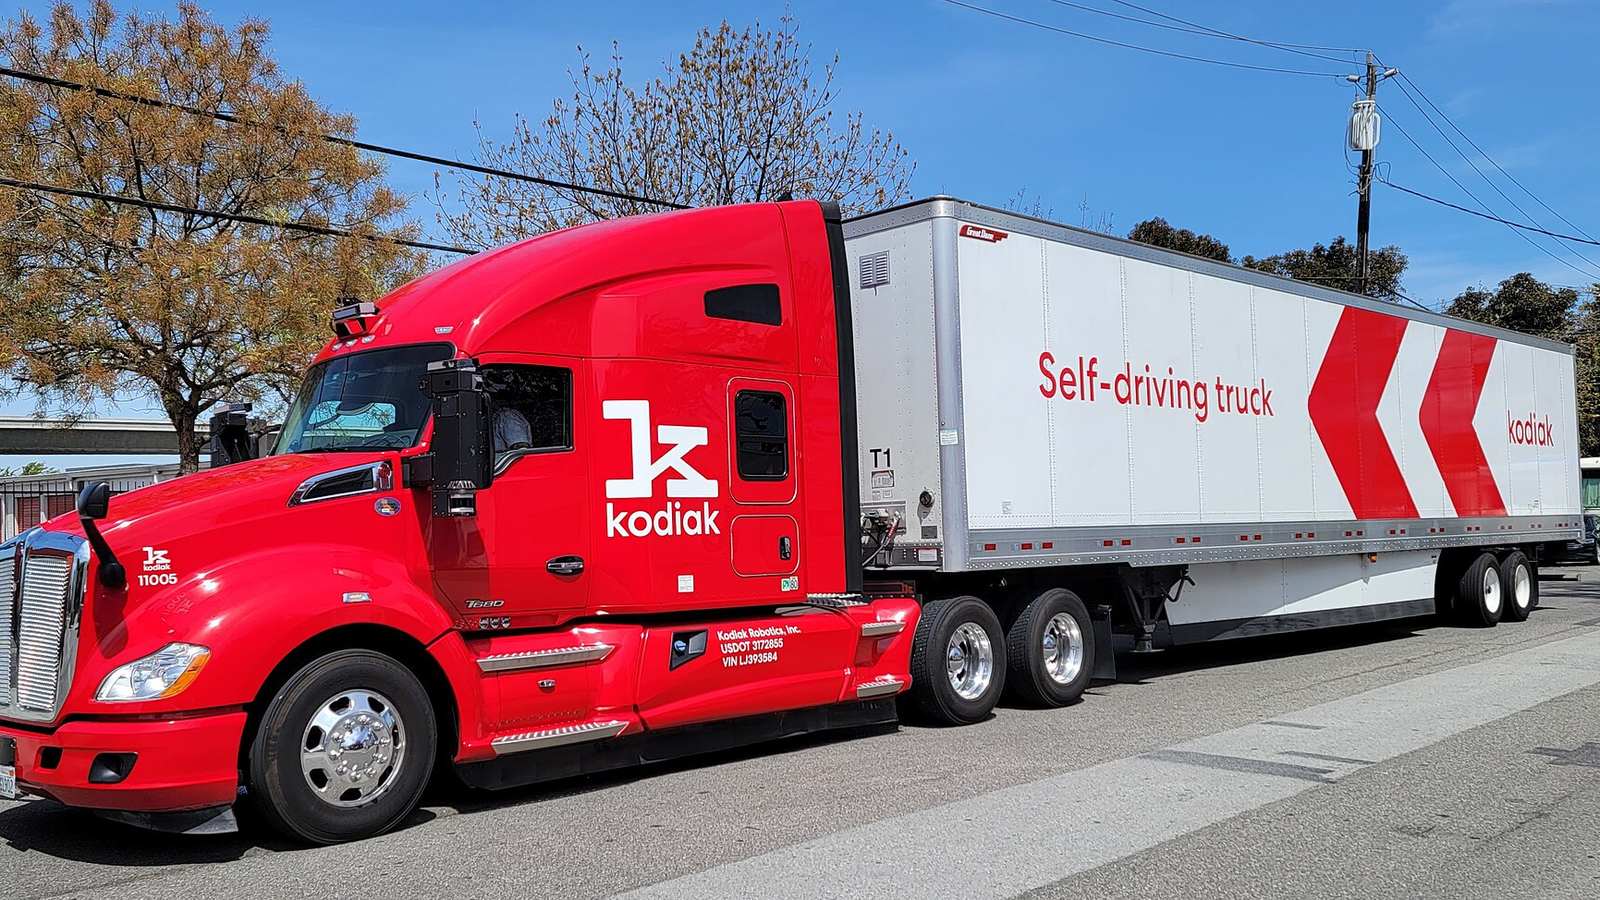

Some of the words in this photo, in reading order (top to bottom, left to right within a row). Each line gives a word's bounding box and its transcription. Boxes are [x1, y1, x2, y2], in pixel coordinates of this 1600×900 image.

[1039, 351, 1208, 422] Self-driving
[1215, 376, 1274, 416] truck
[1507, 409, 1554, 447] kodiak
[869, 448, 891, 468] T1
[606, 501, 721, 537] kodiak
[143, 563, 171, 571] kodiak
[137, 573, 178, 586] 11005
[465, 599, 505, 608] T680
[717, 629, 749, 641] Kodiak
[748, 626, 787, 638] Robotics,
[786, 624, 802, 634] Inc.
[720, 642, 751, 654] USDOT
[752, 638, 784, 650] 3172855
[722, 654, 738, 668] VIN
[739, 652, 778, 665] LJ393584
